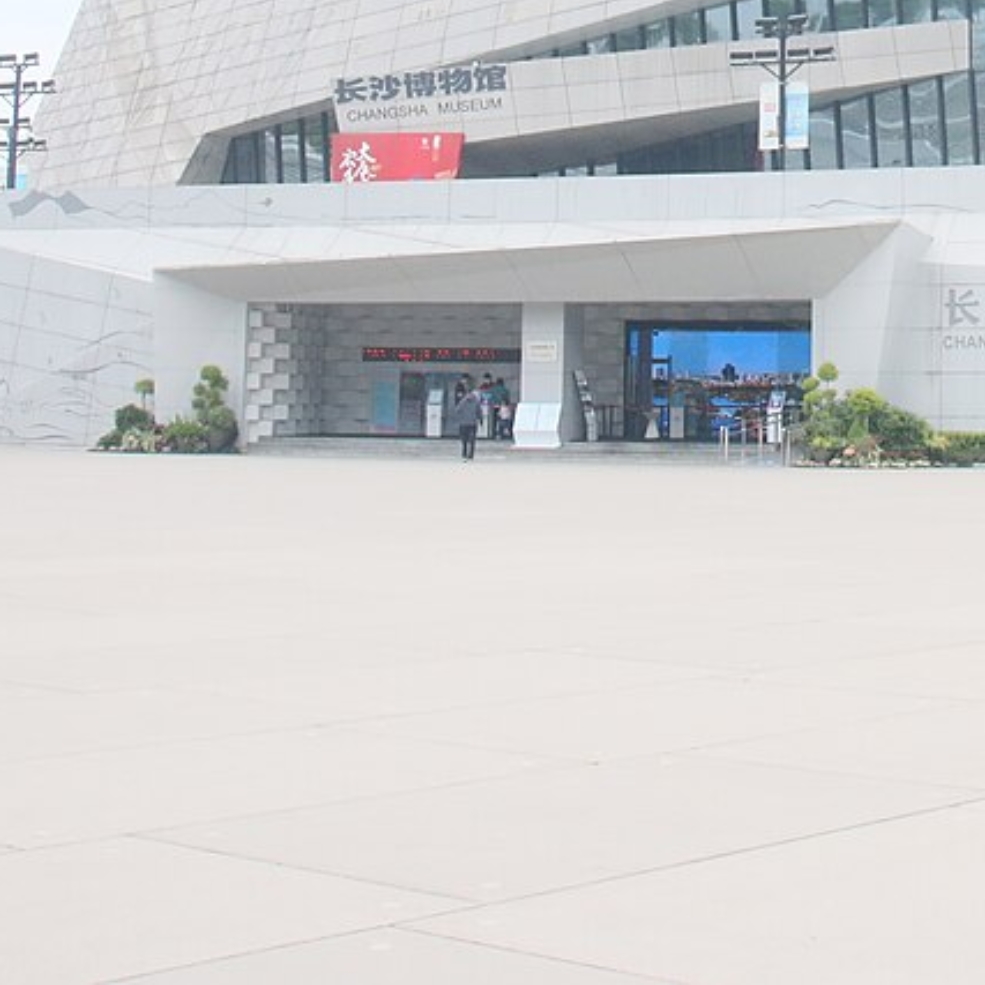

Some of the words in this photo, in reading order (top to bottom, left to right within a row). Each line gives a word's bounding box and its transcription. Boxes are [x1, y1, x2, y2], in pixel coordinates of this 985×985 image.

[334, 65, 507, 104] 长沙博物馆
[346, 103, 428, 122] CHANGSHA
[438, 97, 502, 115] MUSEUM
